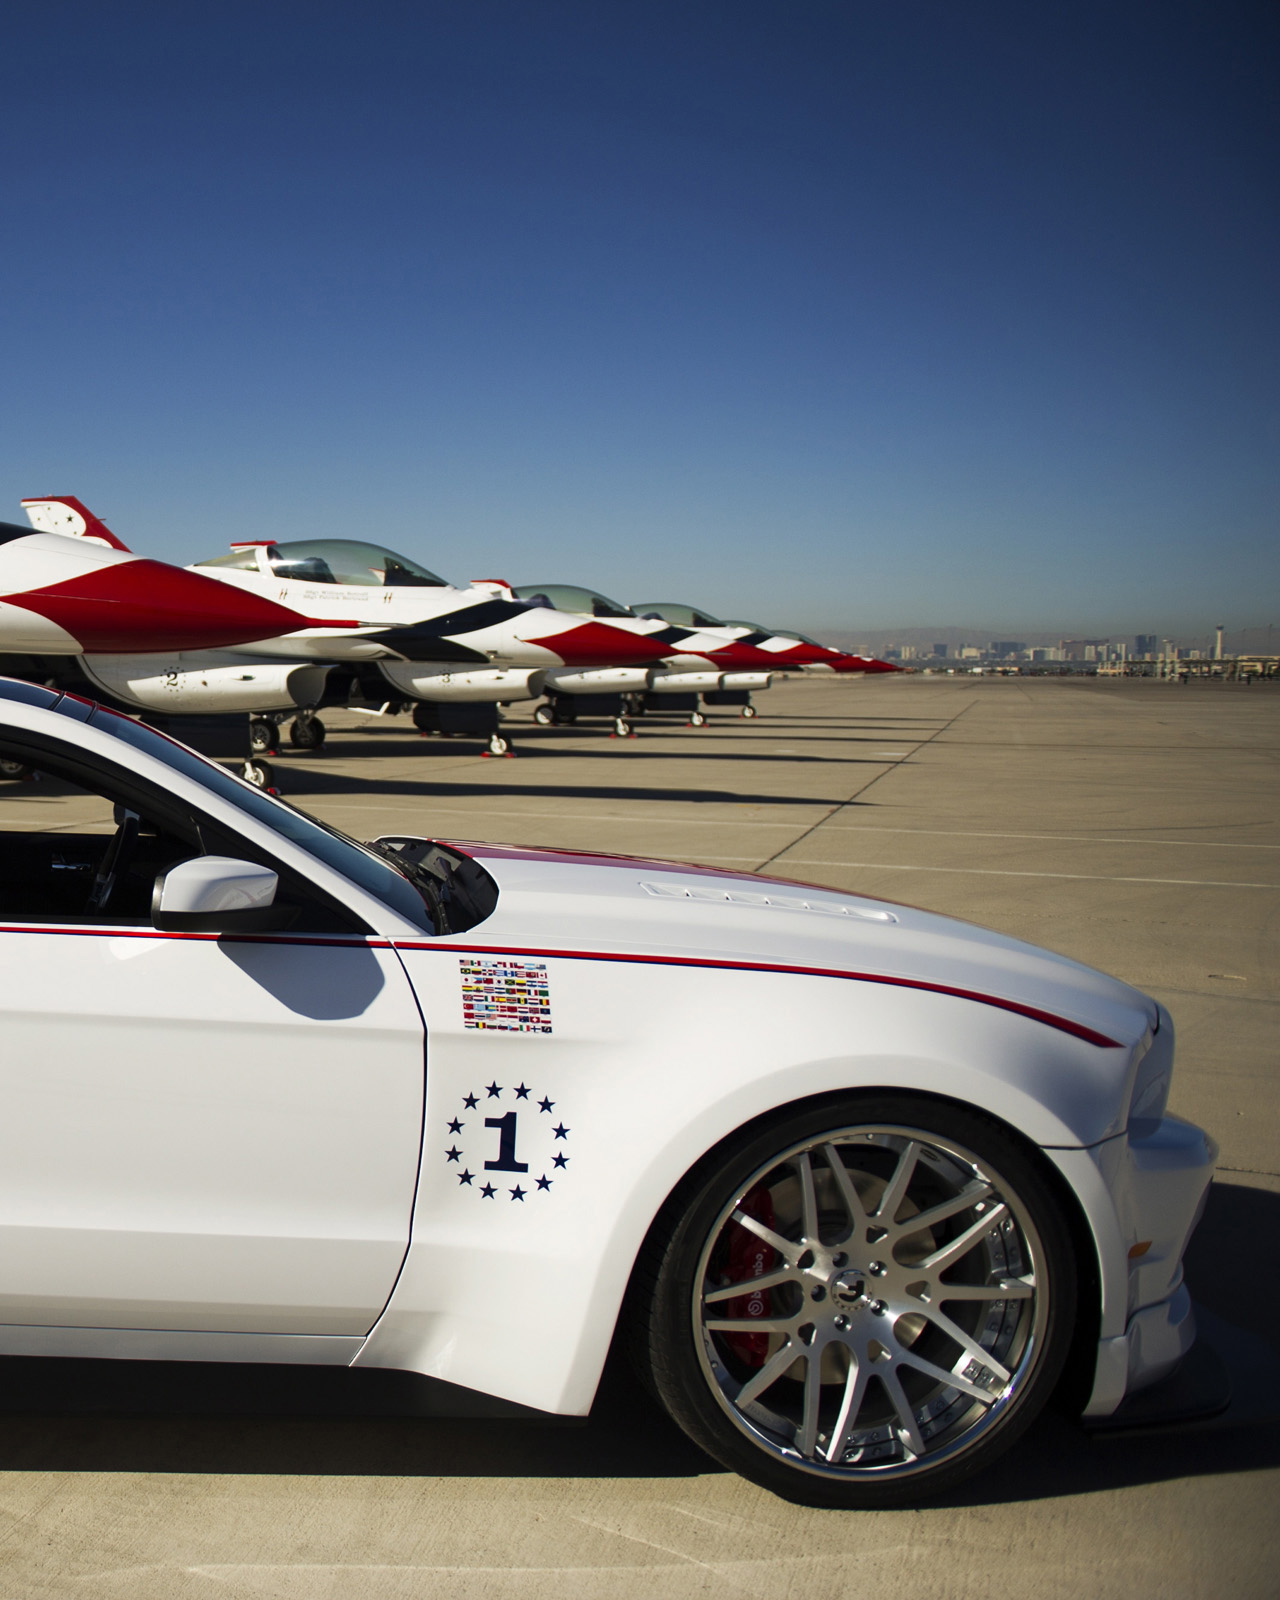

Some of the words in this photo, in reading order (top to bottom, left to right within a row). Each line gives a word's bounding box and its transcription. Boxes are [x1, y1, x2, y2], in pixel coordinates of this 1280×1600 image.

[166, 670, 179, 687] 2
[442, 672, 451, 683] 3
[484, 1111, 529, 1173] 1
[751, 1252, 764, 1299] bmbo
